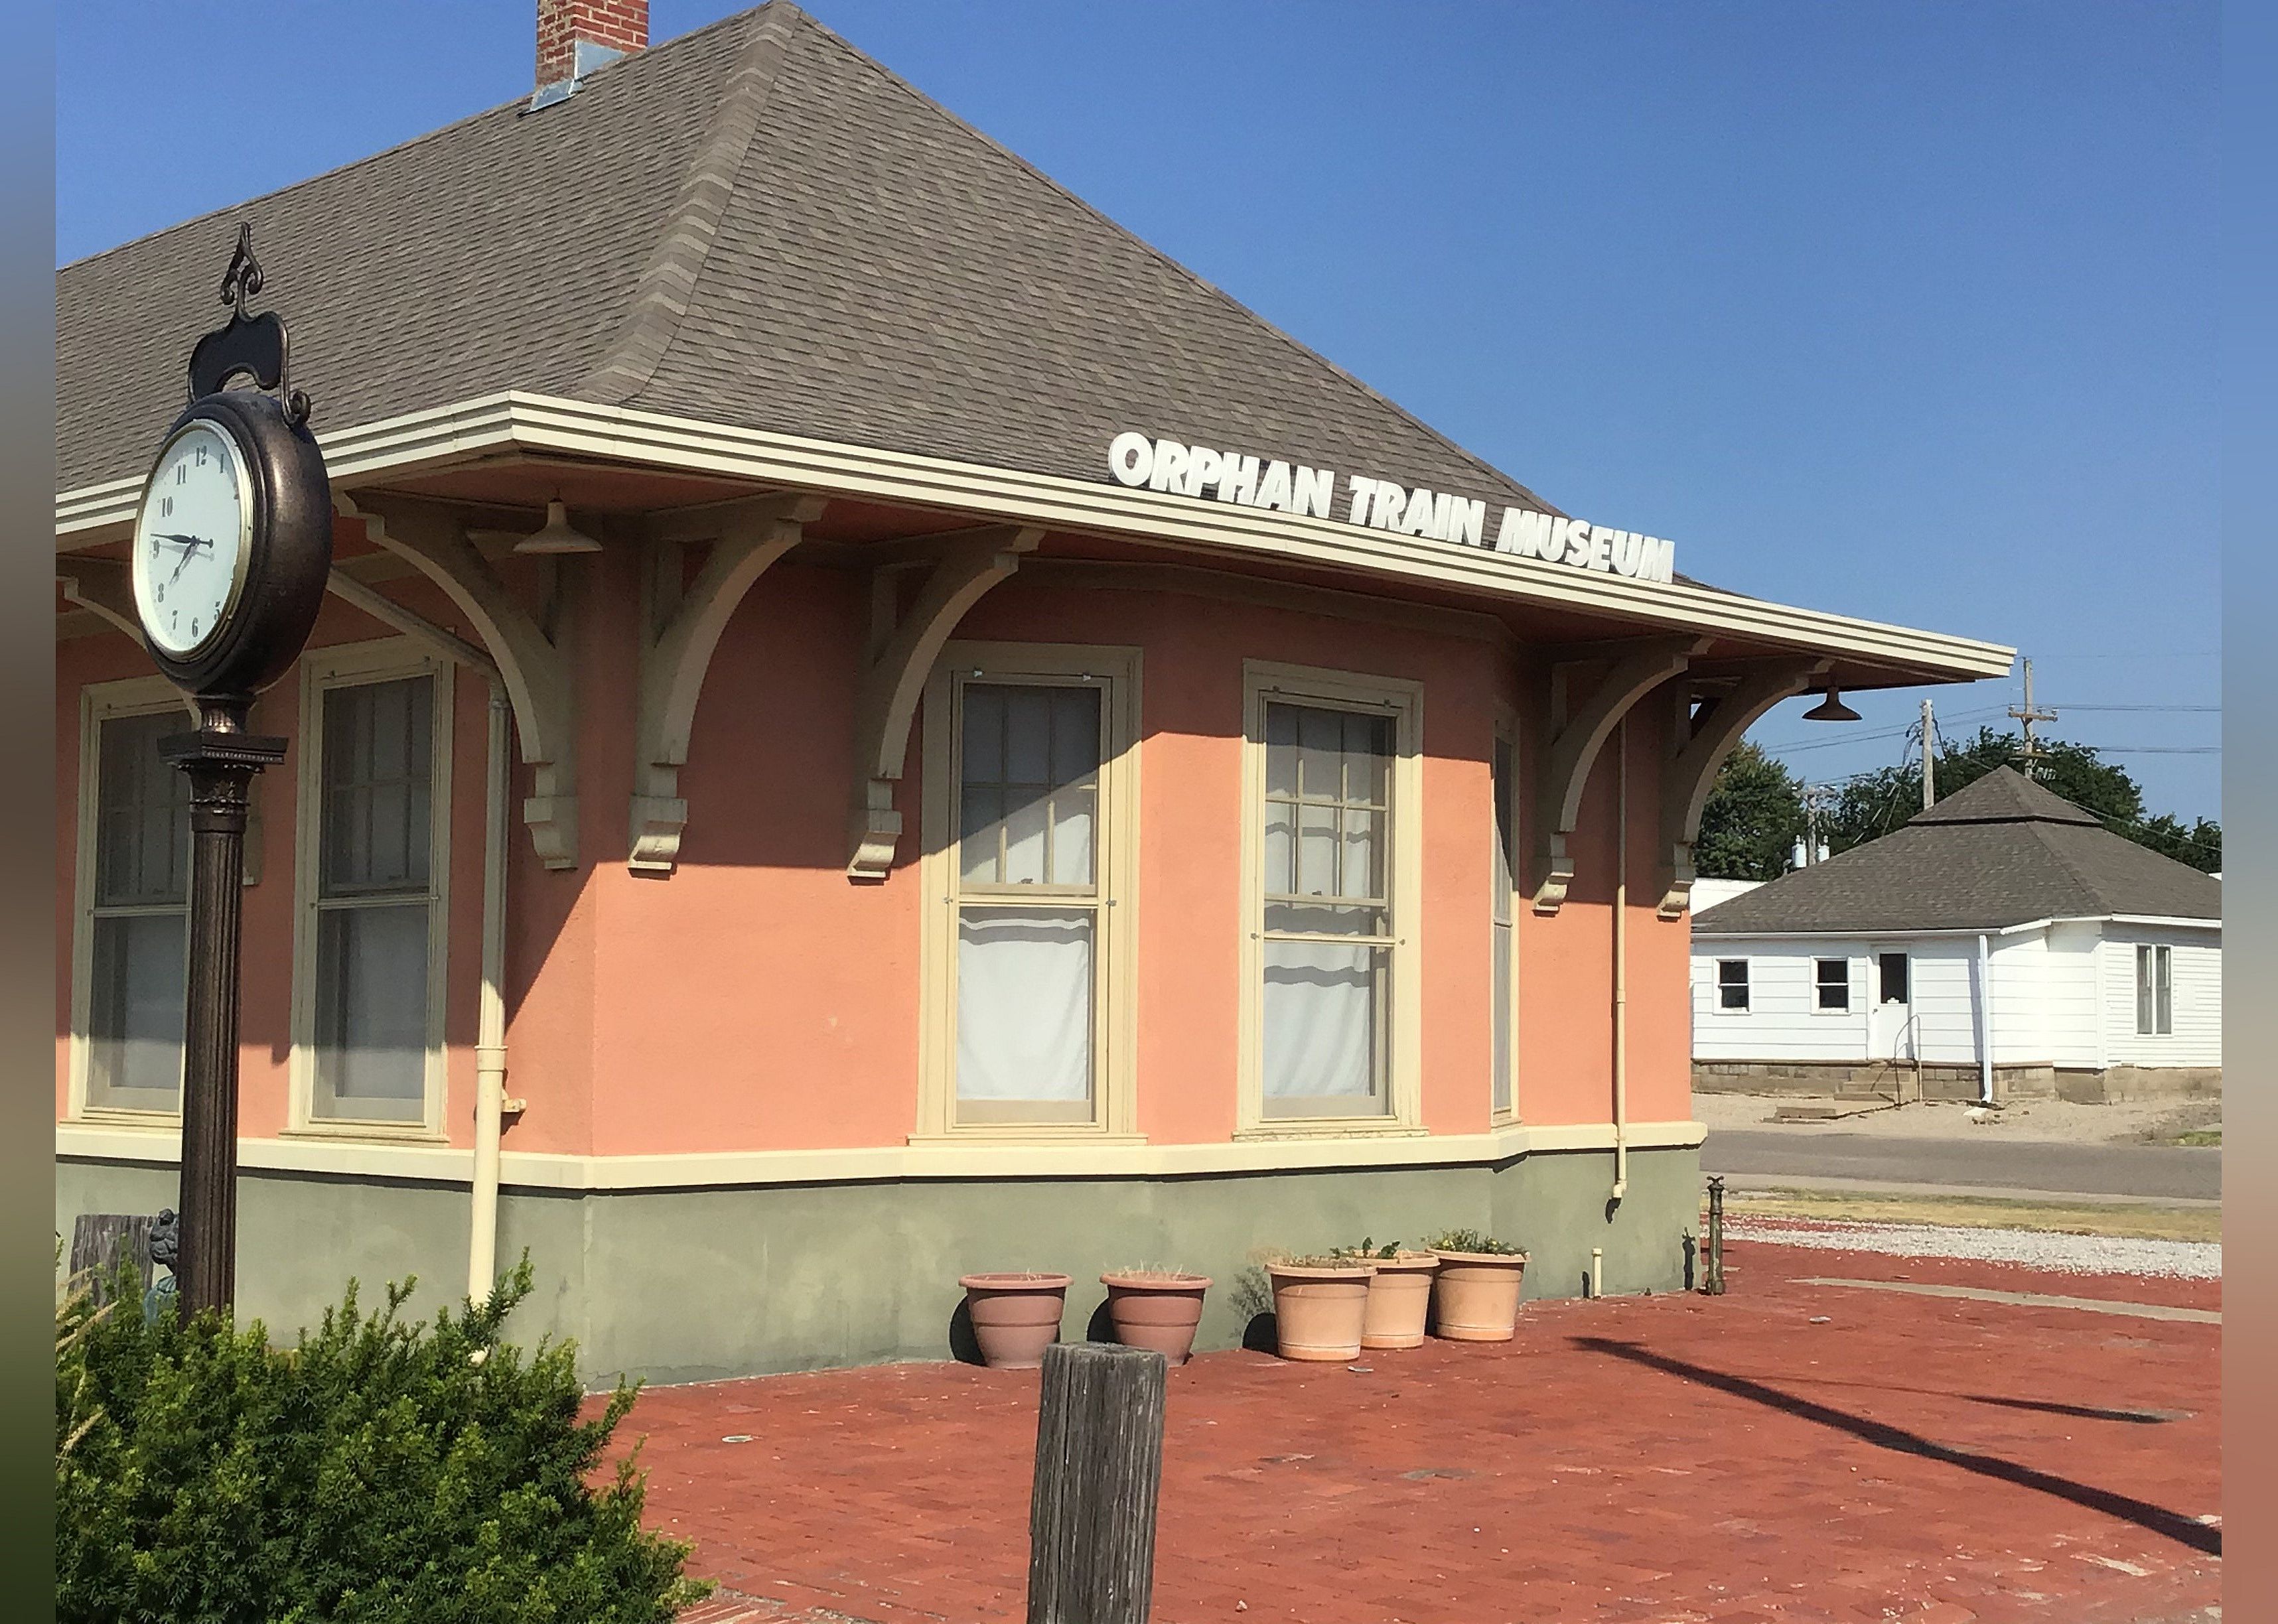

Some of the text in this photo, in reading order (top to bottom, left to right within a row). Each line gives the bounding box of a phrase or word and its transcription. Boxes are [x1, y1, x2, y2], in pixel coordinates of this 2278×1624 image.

[195, 445, 207, 467] 12
[220, 453, 224, 474] 1
[176, 464, 186, 486] 11
[161, 496, 173, 517] 10
[1108, 431, 1675, 584] ORPHAN TRAIN MUSEUM
[153, 540, 161, 559] 9
[157, 582, 165, 602] 8
[192, 617, 198, 638] 6
